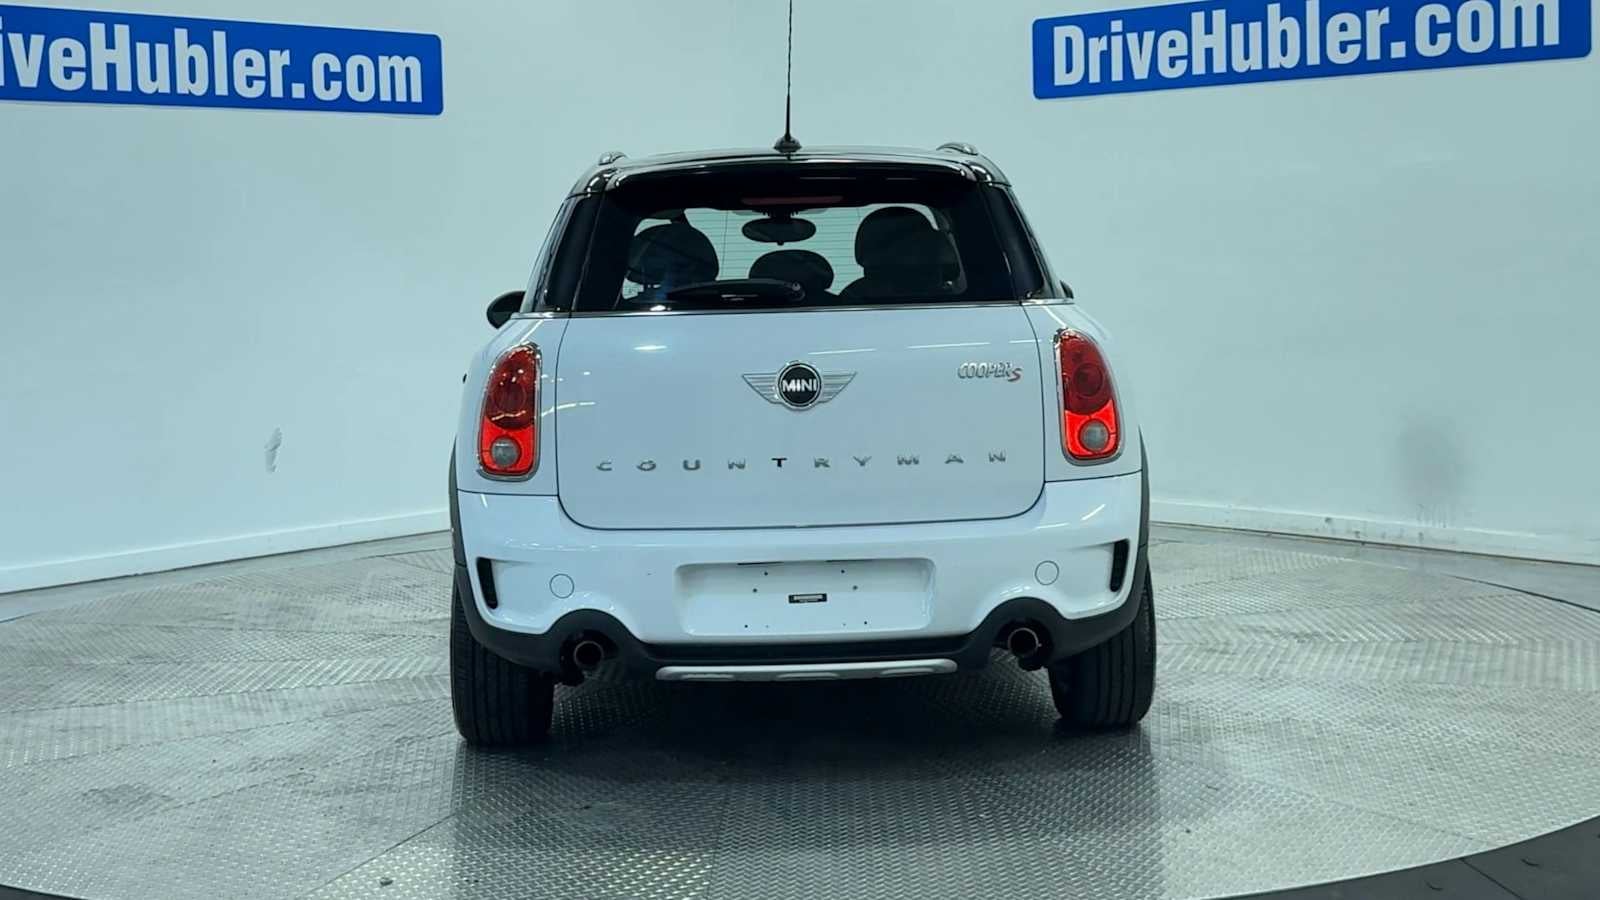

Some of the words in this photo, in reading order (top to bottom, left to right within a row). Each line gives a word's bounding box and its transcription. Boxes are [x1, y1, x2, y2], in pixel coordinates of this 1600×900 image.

[1053, 0, 1560, 87] DriveHubler.com
[782, 378, 817, 392] MINI
[596, 451, 1006, 471] COUNTRYMAN
